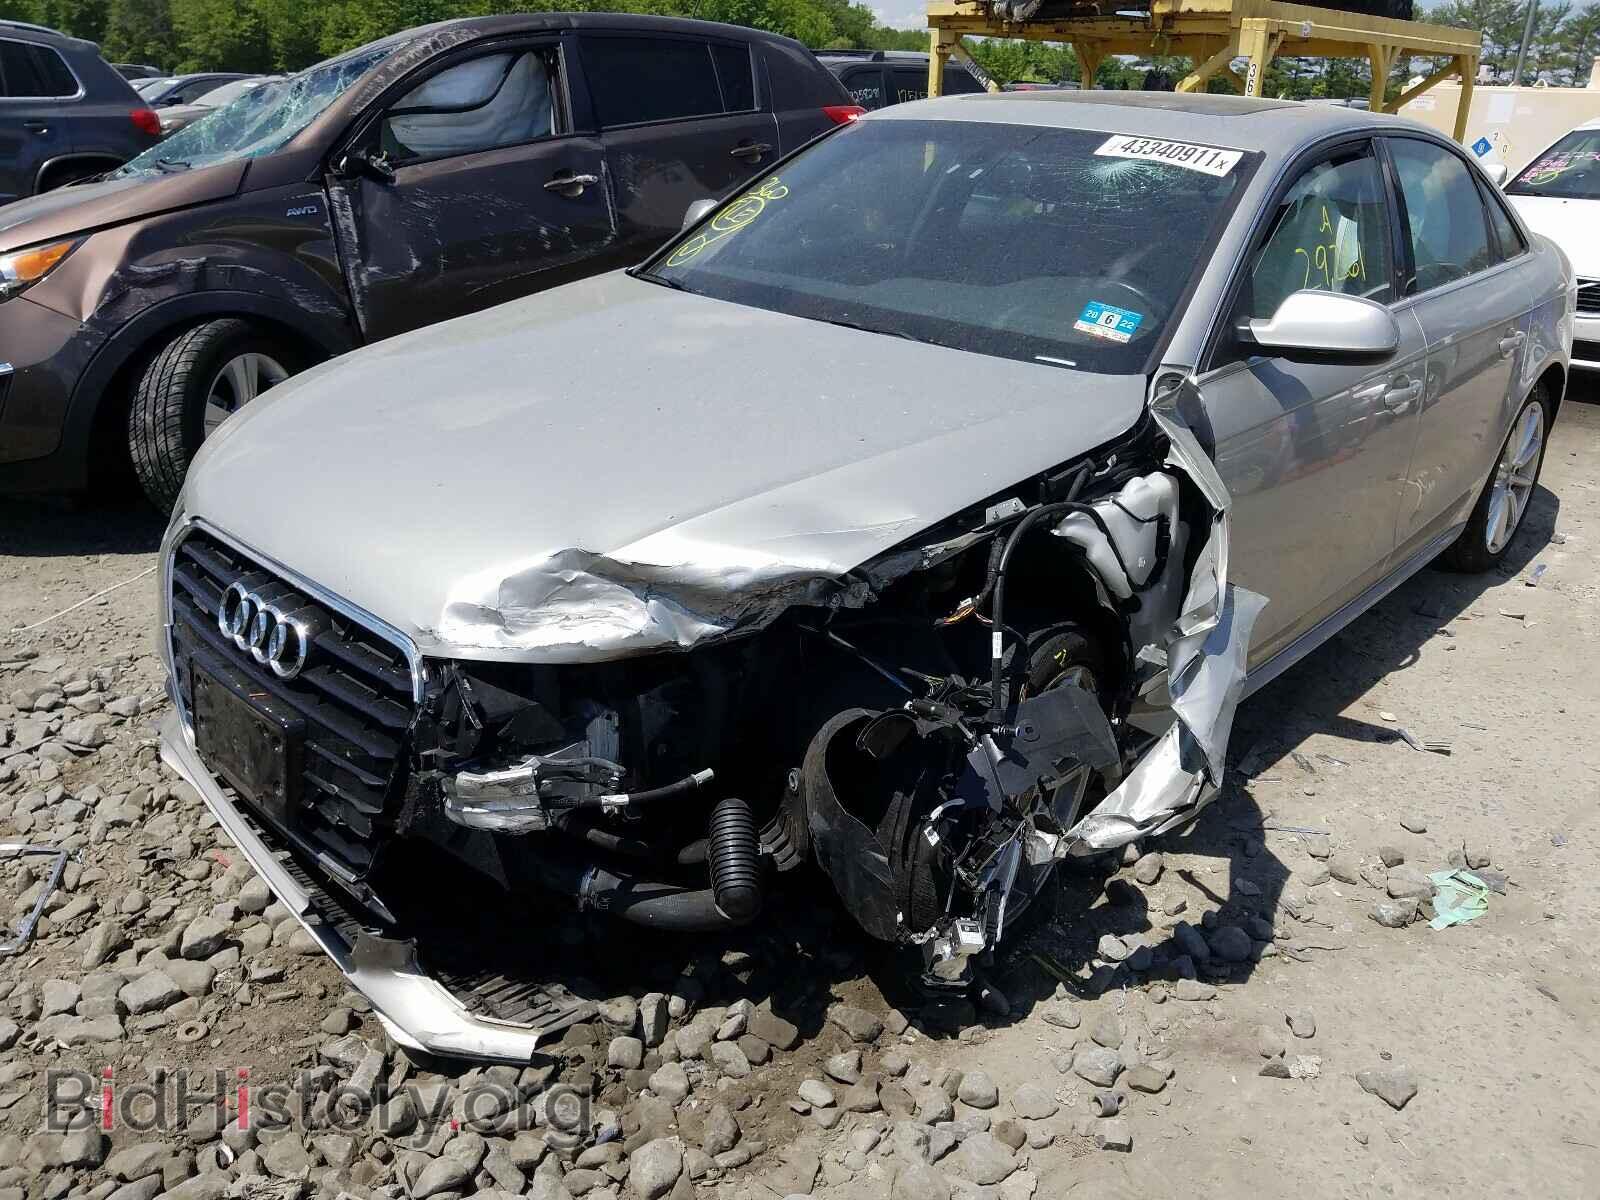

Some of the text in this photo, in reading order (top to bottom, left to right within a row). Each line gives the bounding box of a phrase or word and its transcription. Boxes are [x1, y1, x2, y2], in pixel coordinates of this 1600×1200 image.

[1120, 138, 1222, 167] 43340911
[286, 206, 317, 217] AWD
[1104, 314, 1115, 325] 6
[1119, 319, 1135, 330] 22
